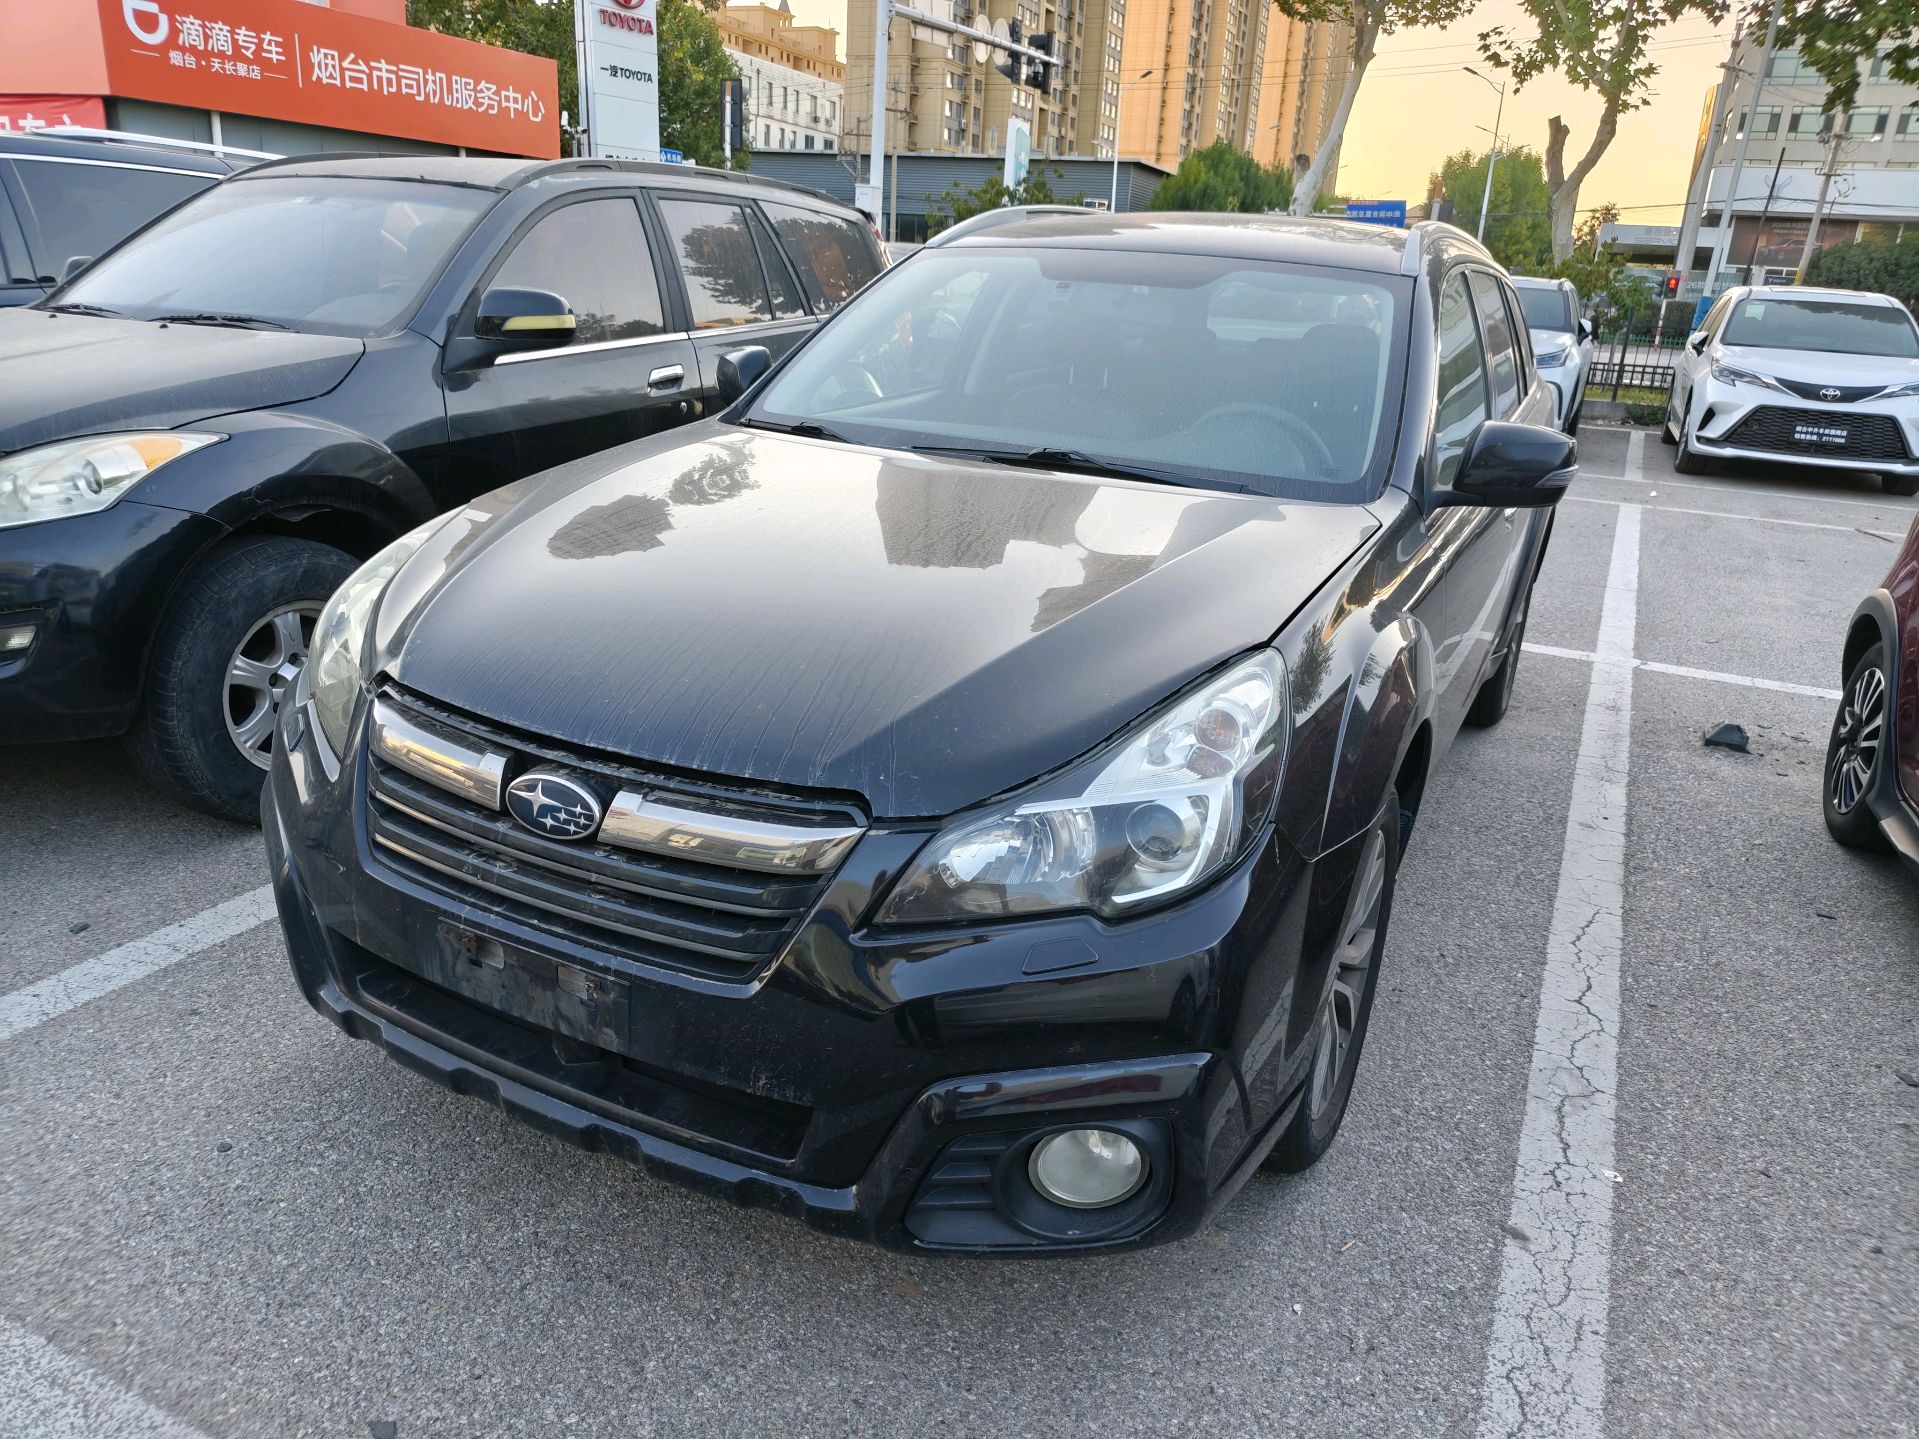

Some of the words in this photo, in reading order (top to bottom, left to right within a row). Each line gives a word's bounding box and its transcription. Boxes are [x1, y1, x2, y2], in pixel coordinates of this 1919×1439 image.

[174, 14, 287, 64] 滴滴专车
[600, 8, 655, 36] TOYOTA
[308, 44, 546, 123] 烟台市司机服务中心
[600, 64, 654, 84] 一汽TOYOTA
